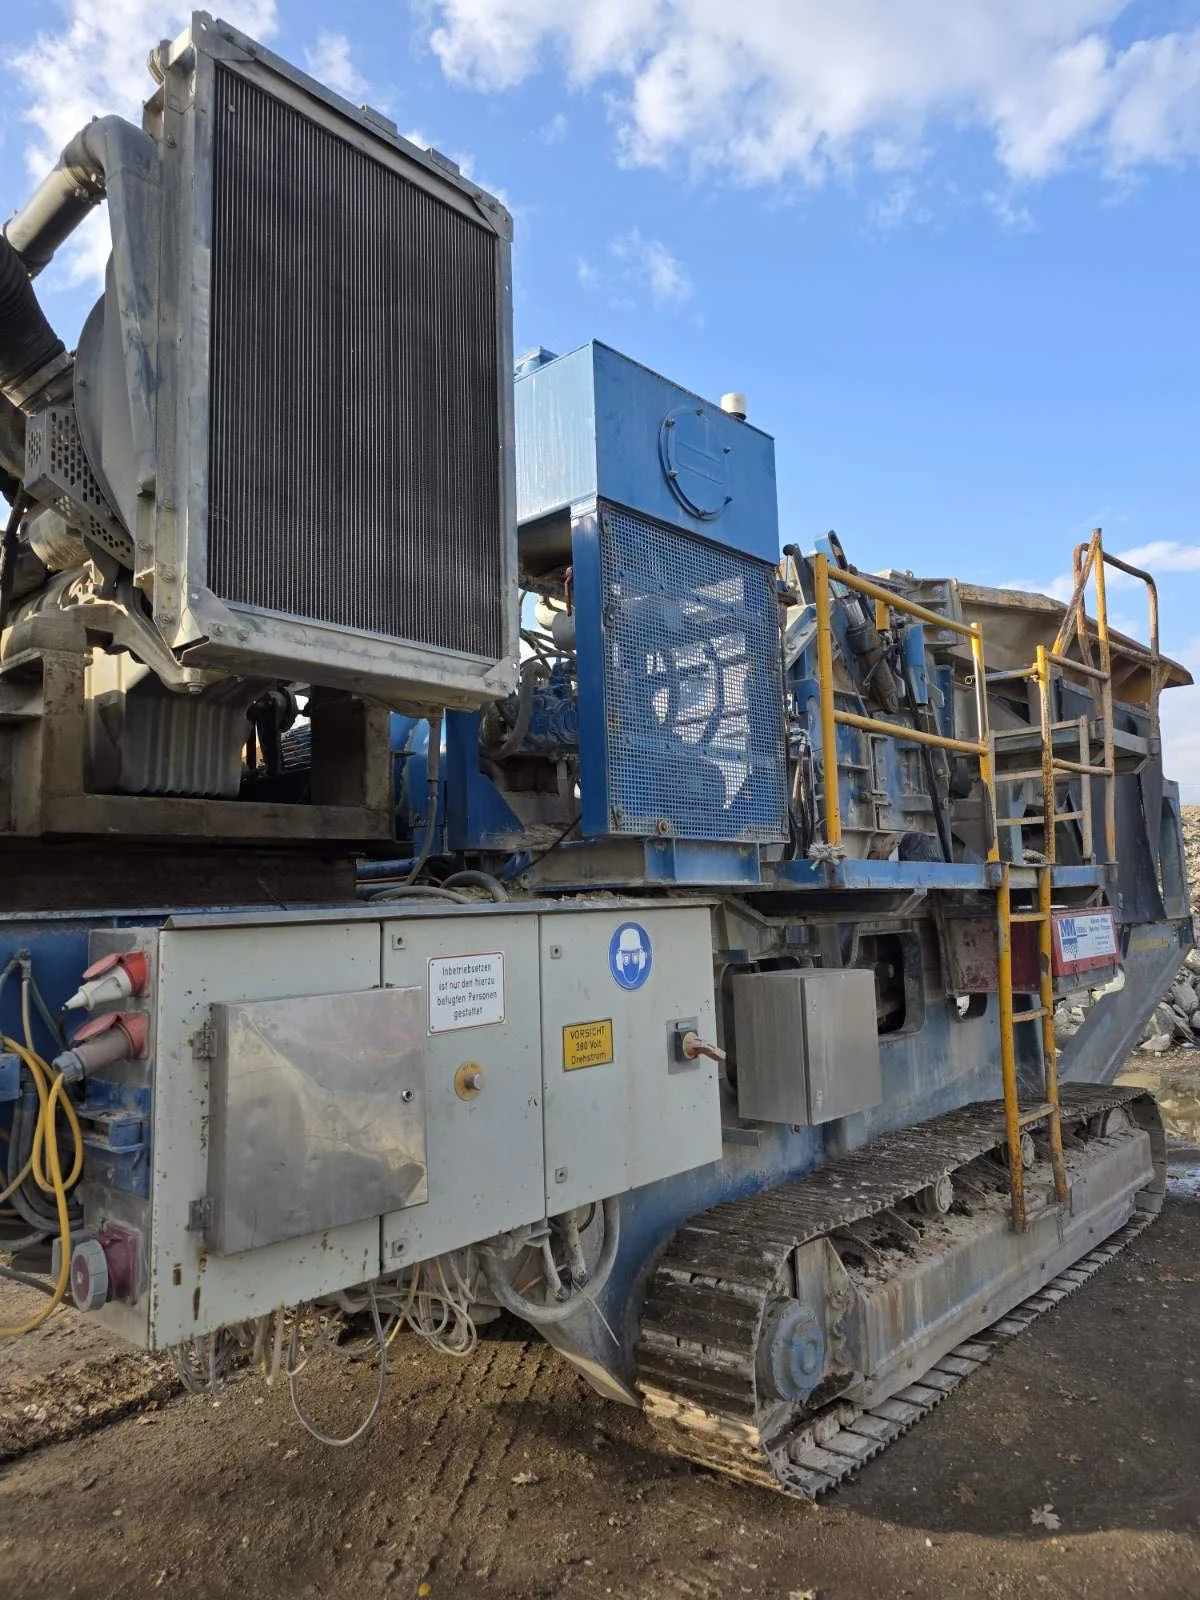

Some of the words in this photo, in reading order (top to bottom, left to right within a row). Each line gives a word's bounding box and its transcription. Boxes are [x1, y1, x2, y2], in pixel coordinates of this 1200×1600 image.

[439, 982, 448, 991] ist
[449, 980, 460, 989] nur
[461, 978, 473, 988] den
[475, 977, 495, 986] hierzu
[570, 1026, 604, 1039] VORSICHT
